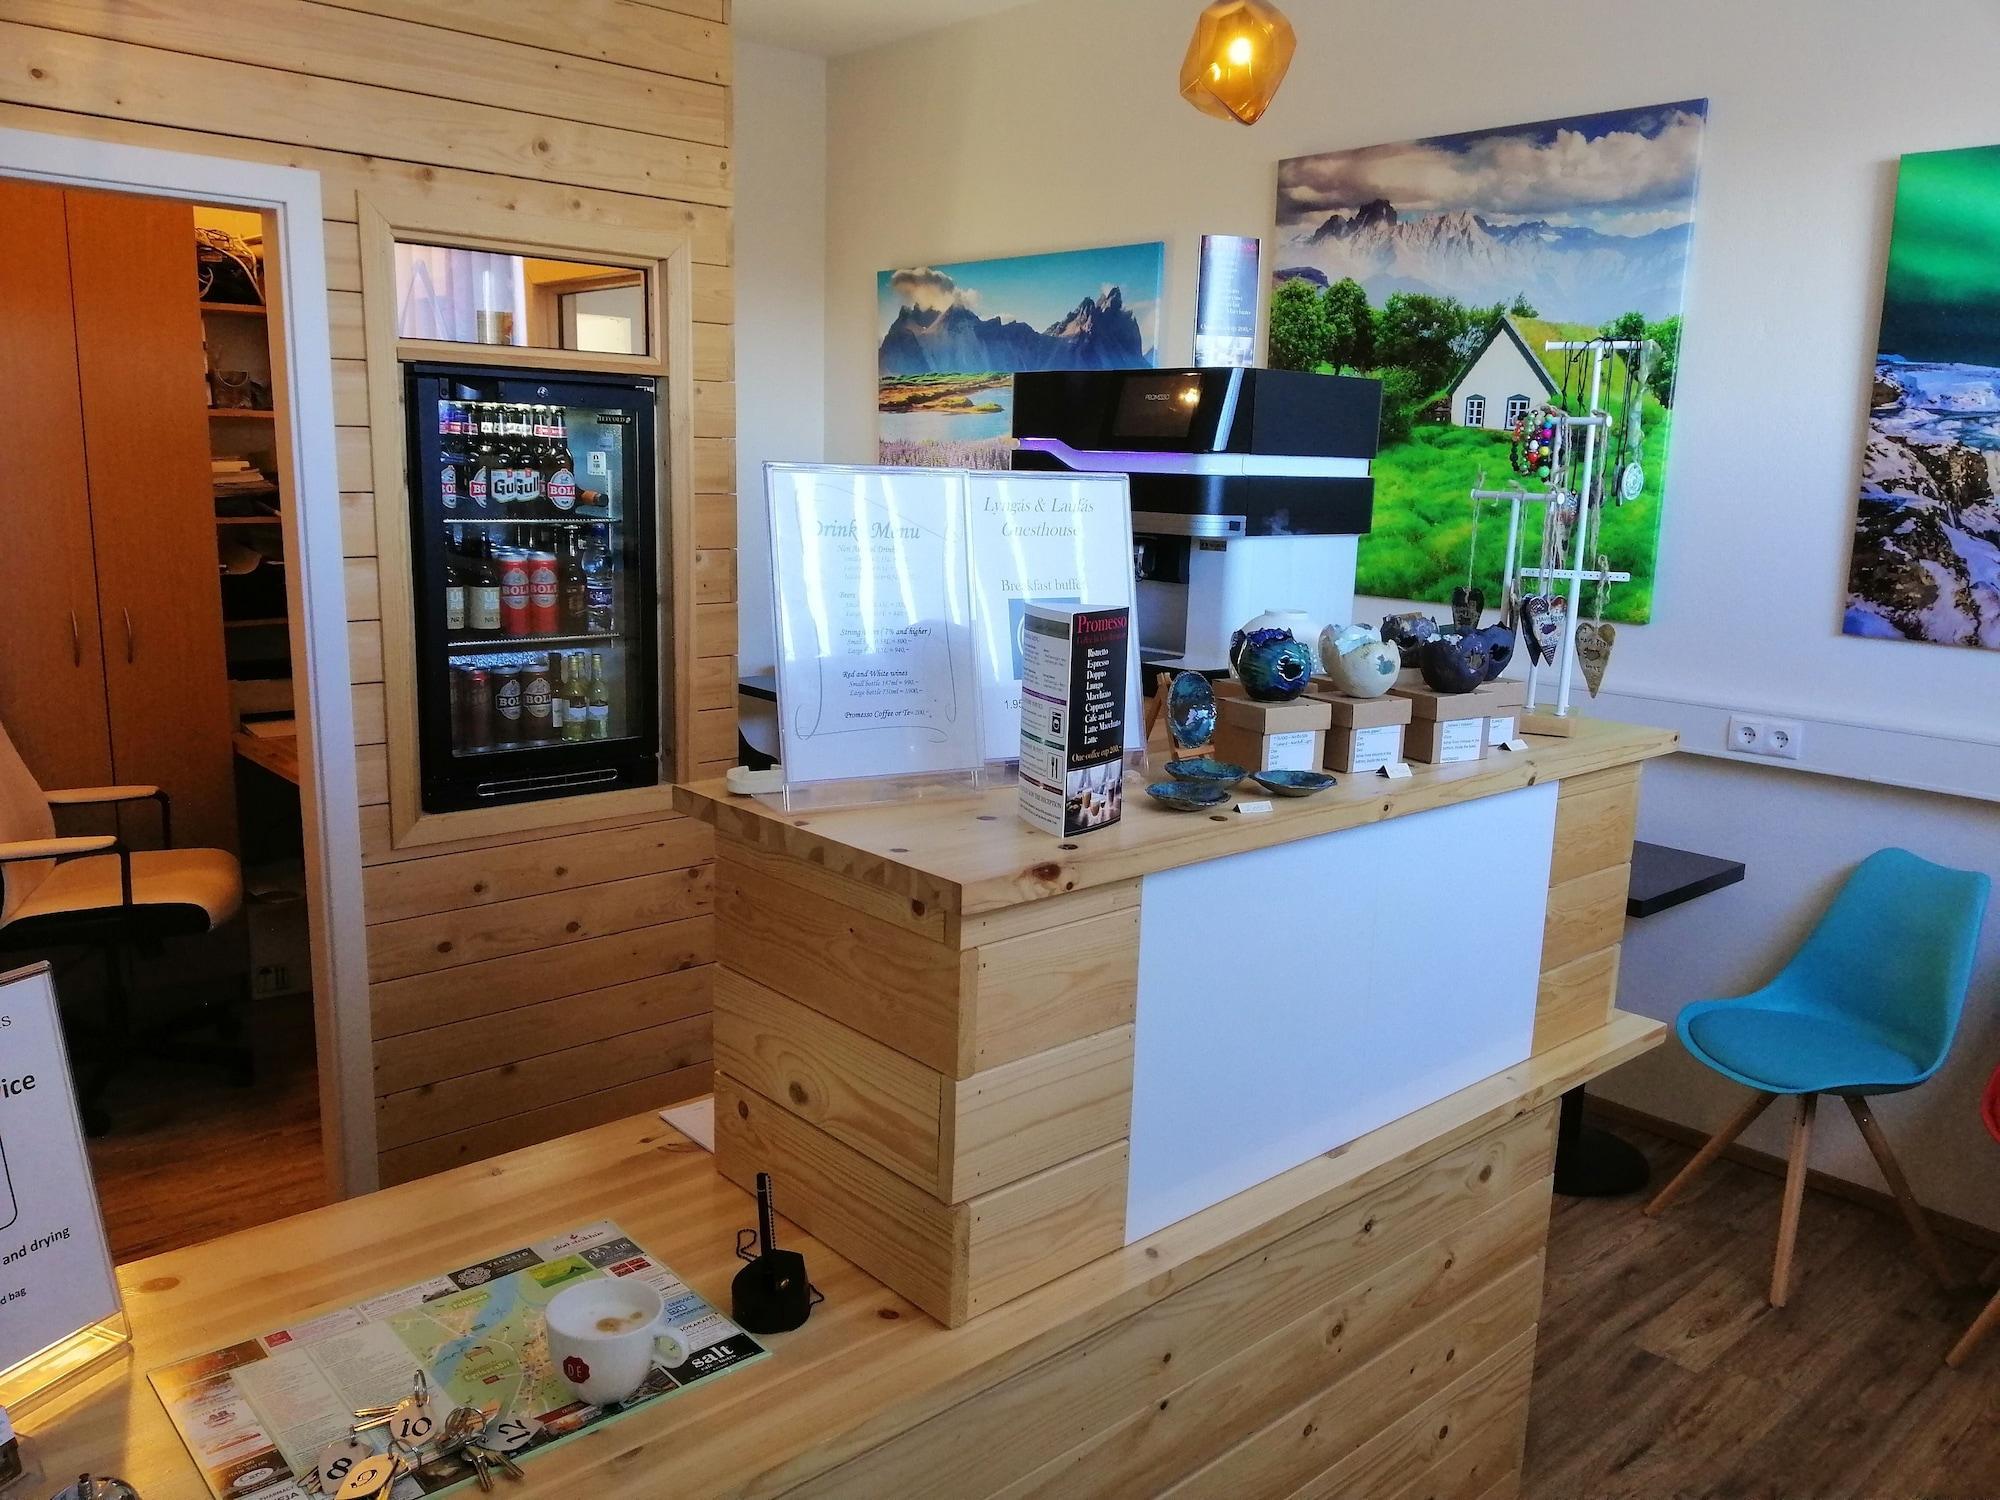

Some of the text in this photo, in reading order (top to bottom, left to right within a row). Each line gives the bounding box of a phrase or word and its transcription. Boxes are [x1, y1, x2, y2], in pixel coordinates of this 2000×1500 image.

[1034, 497, 1047, 512] &
[895, 628, 907, 636] and
[1077, 614, 1127, 634] Promesso
[842, 669, 908, 679] Red and White wines
[844, 711, 873, 719] Promesso
[874, 709, 894, 720] Coffee
[0, 1073, 36, 1098] ice
[2, 1227, 70, 1265] and drying
[8, 1287, 27, 1301] bag
[691, 1345, 734, 1369] salt
[567, 1363, 582, 1378] DE
[400, 1416, 433, 1439] 10
[497, 1418, 531, 1444] 12
[326, 1457, 353, 1480] 8
